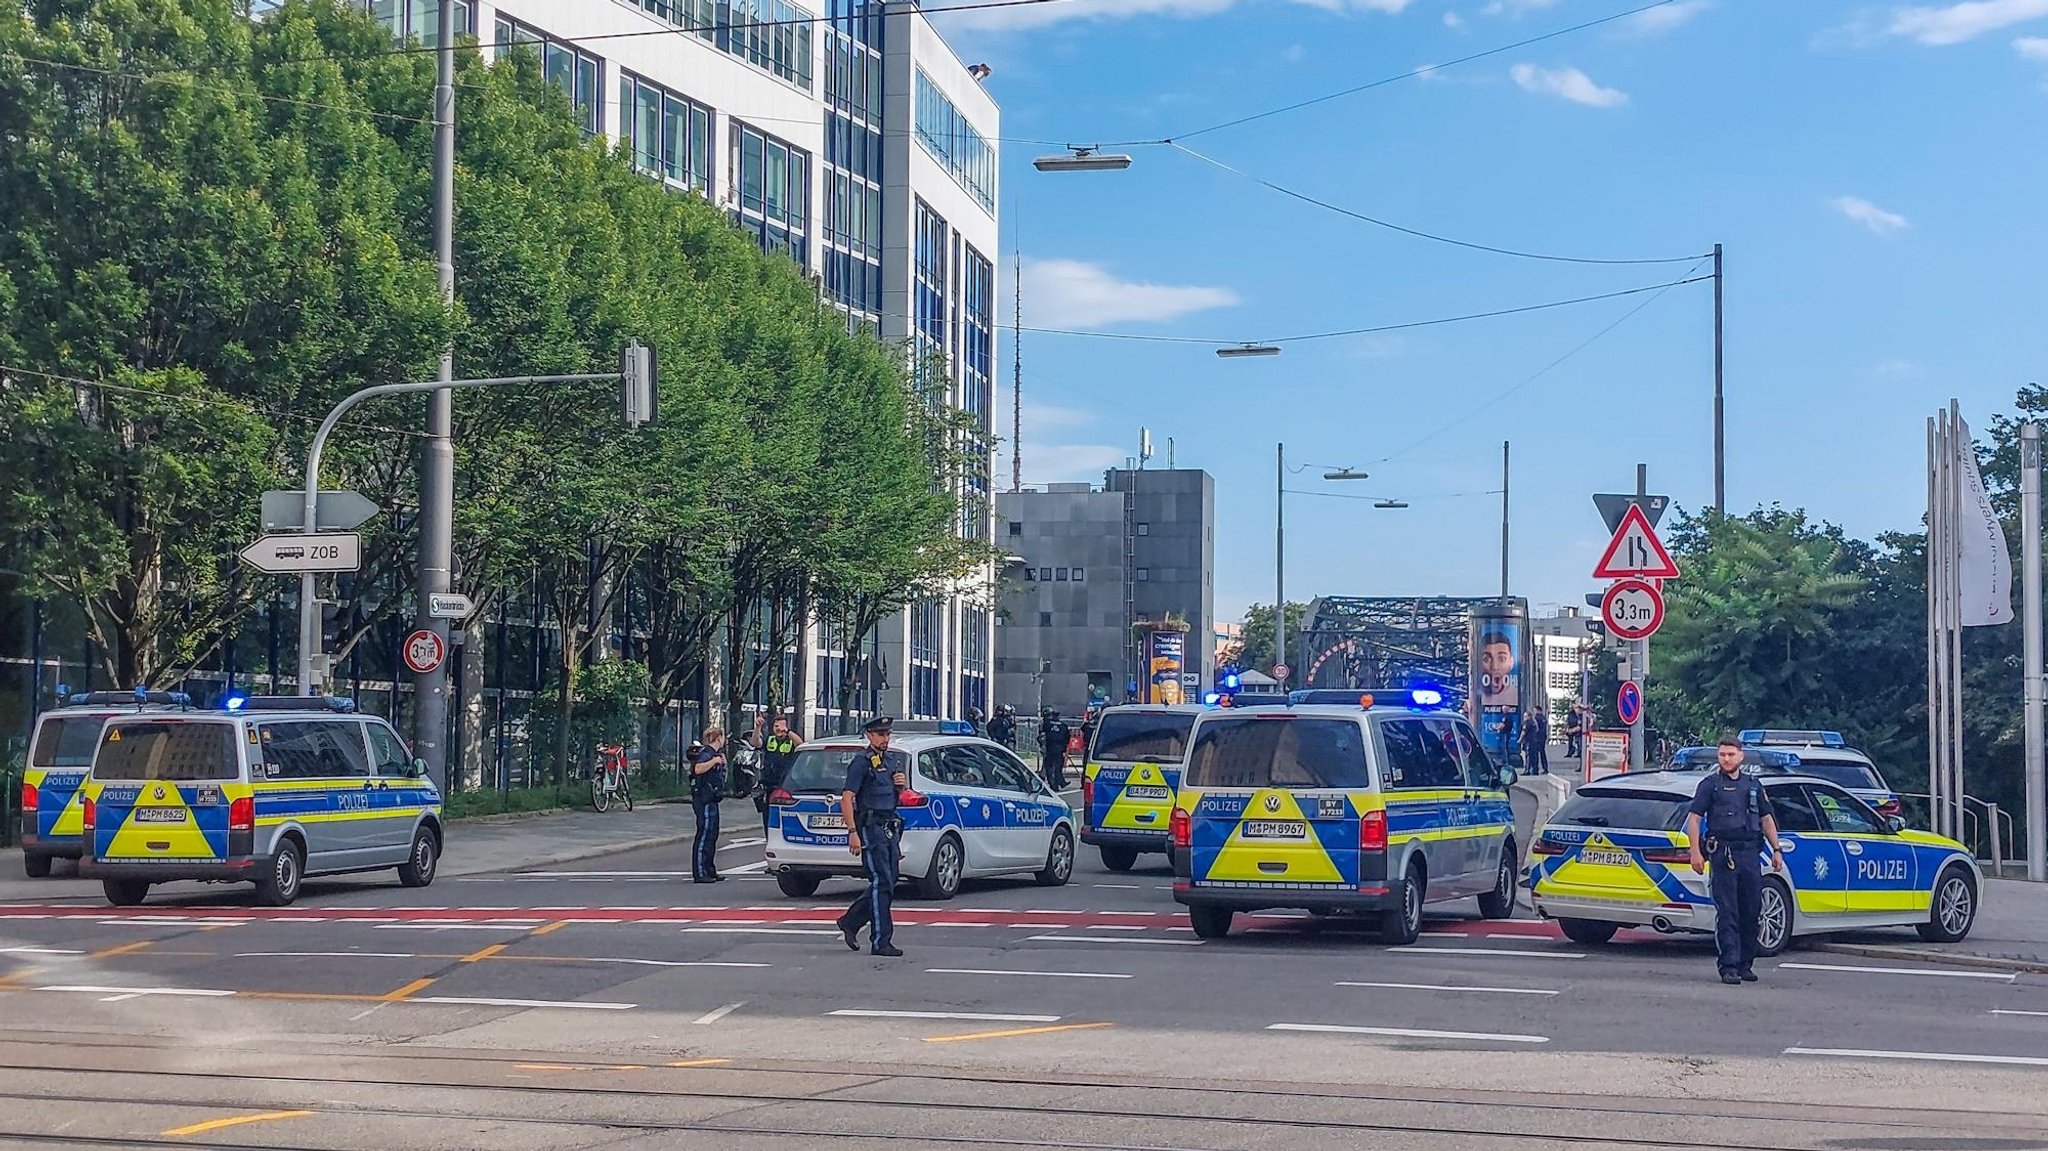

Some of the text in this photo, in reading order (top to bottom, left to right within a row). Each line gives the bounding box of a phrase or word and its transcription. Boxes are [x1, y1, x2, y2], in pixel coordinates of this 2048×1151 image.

[310, 546, 339, 559] ZOB
[1100, 769, 1126, 780] POLIZEI
[46, 777, 79, 786] POLIZEI
[103, 791, 135, 801] POLIZEI
[337, 794, 369, 809] POLIZEI
[1201, 801, 1242, 812] POLIZEI
[1015, 808, 1044, 822] POLIZEI
[1277, 824, 1304, 834] 8967
[815, 835, 848, 844] POLIZEI
[1551, 830, 1580, 841] POLIZEI
[1606, 852, 1630, 865] 8120
[1858, 859, 1908, 880] POLIZEI
